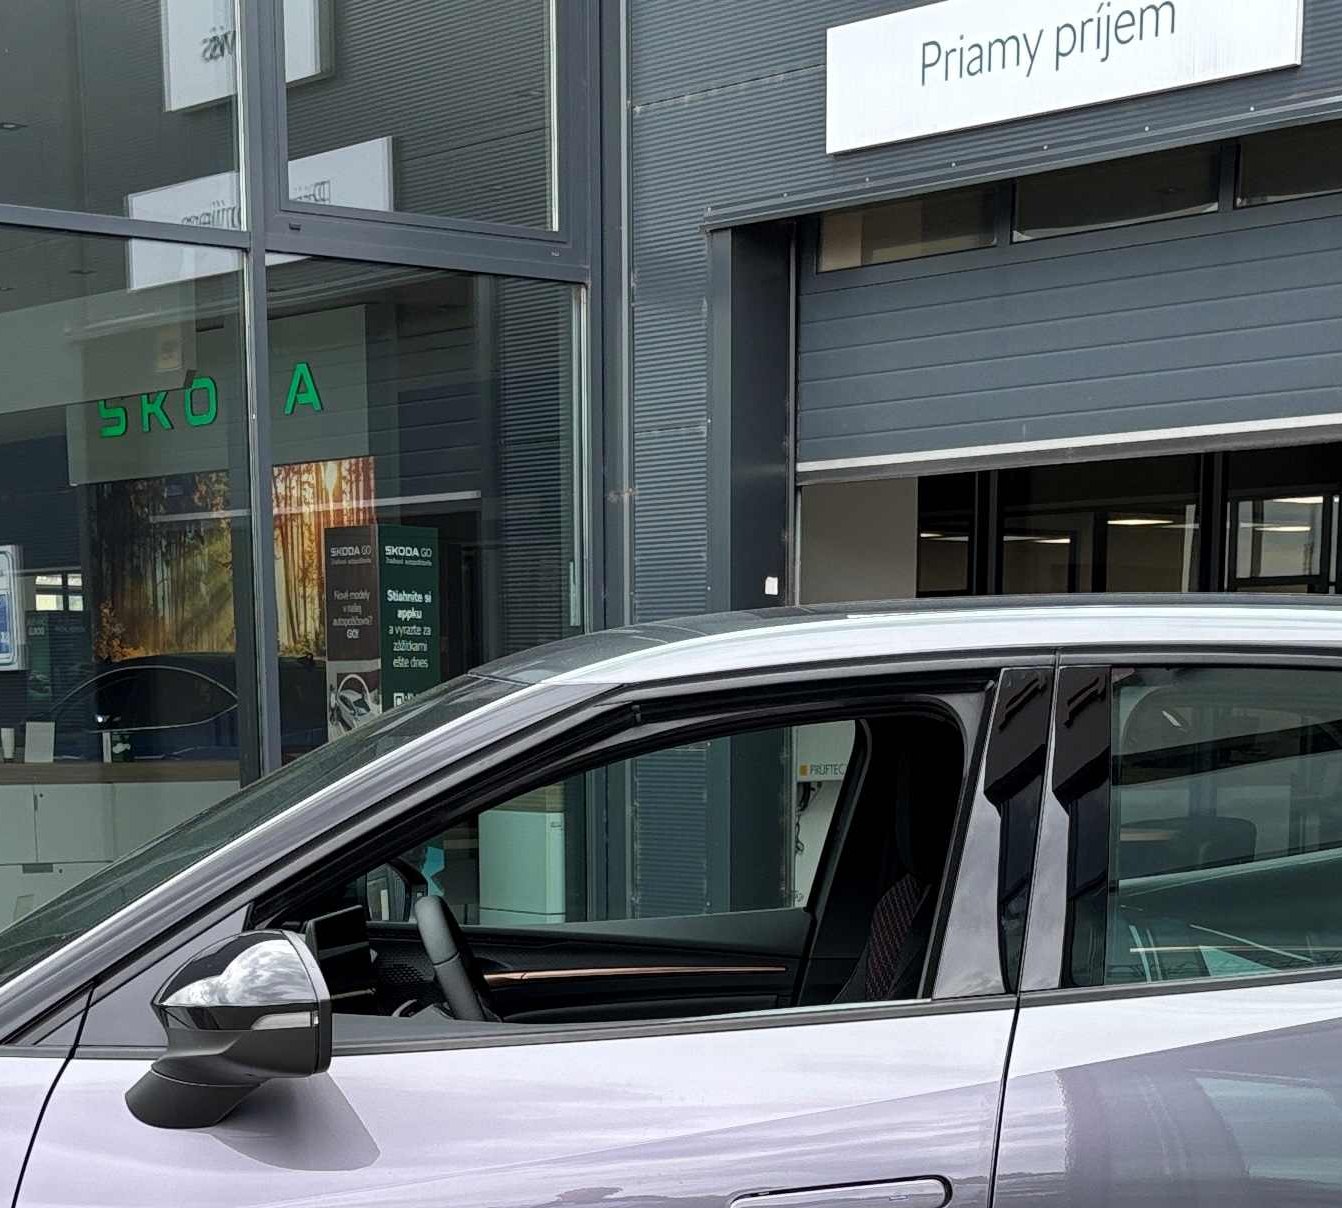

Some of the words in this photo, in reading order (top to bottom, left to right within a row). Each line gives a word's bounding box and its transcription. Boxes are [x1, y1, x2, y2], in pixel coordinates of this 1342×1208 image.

[921, 28, 1044, 86] Priamy
[1055, 0, 1175, 71] príjem
[397, 607, 423, 621] appku
[410, 657, 429, 668] dnes
